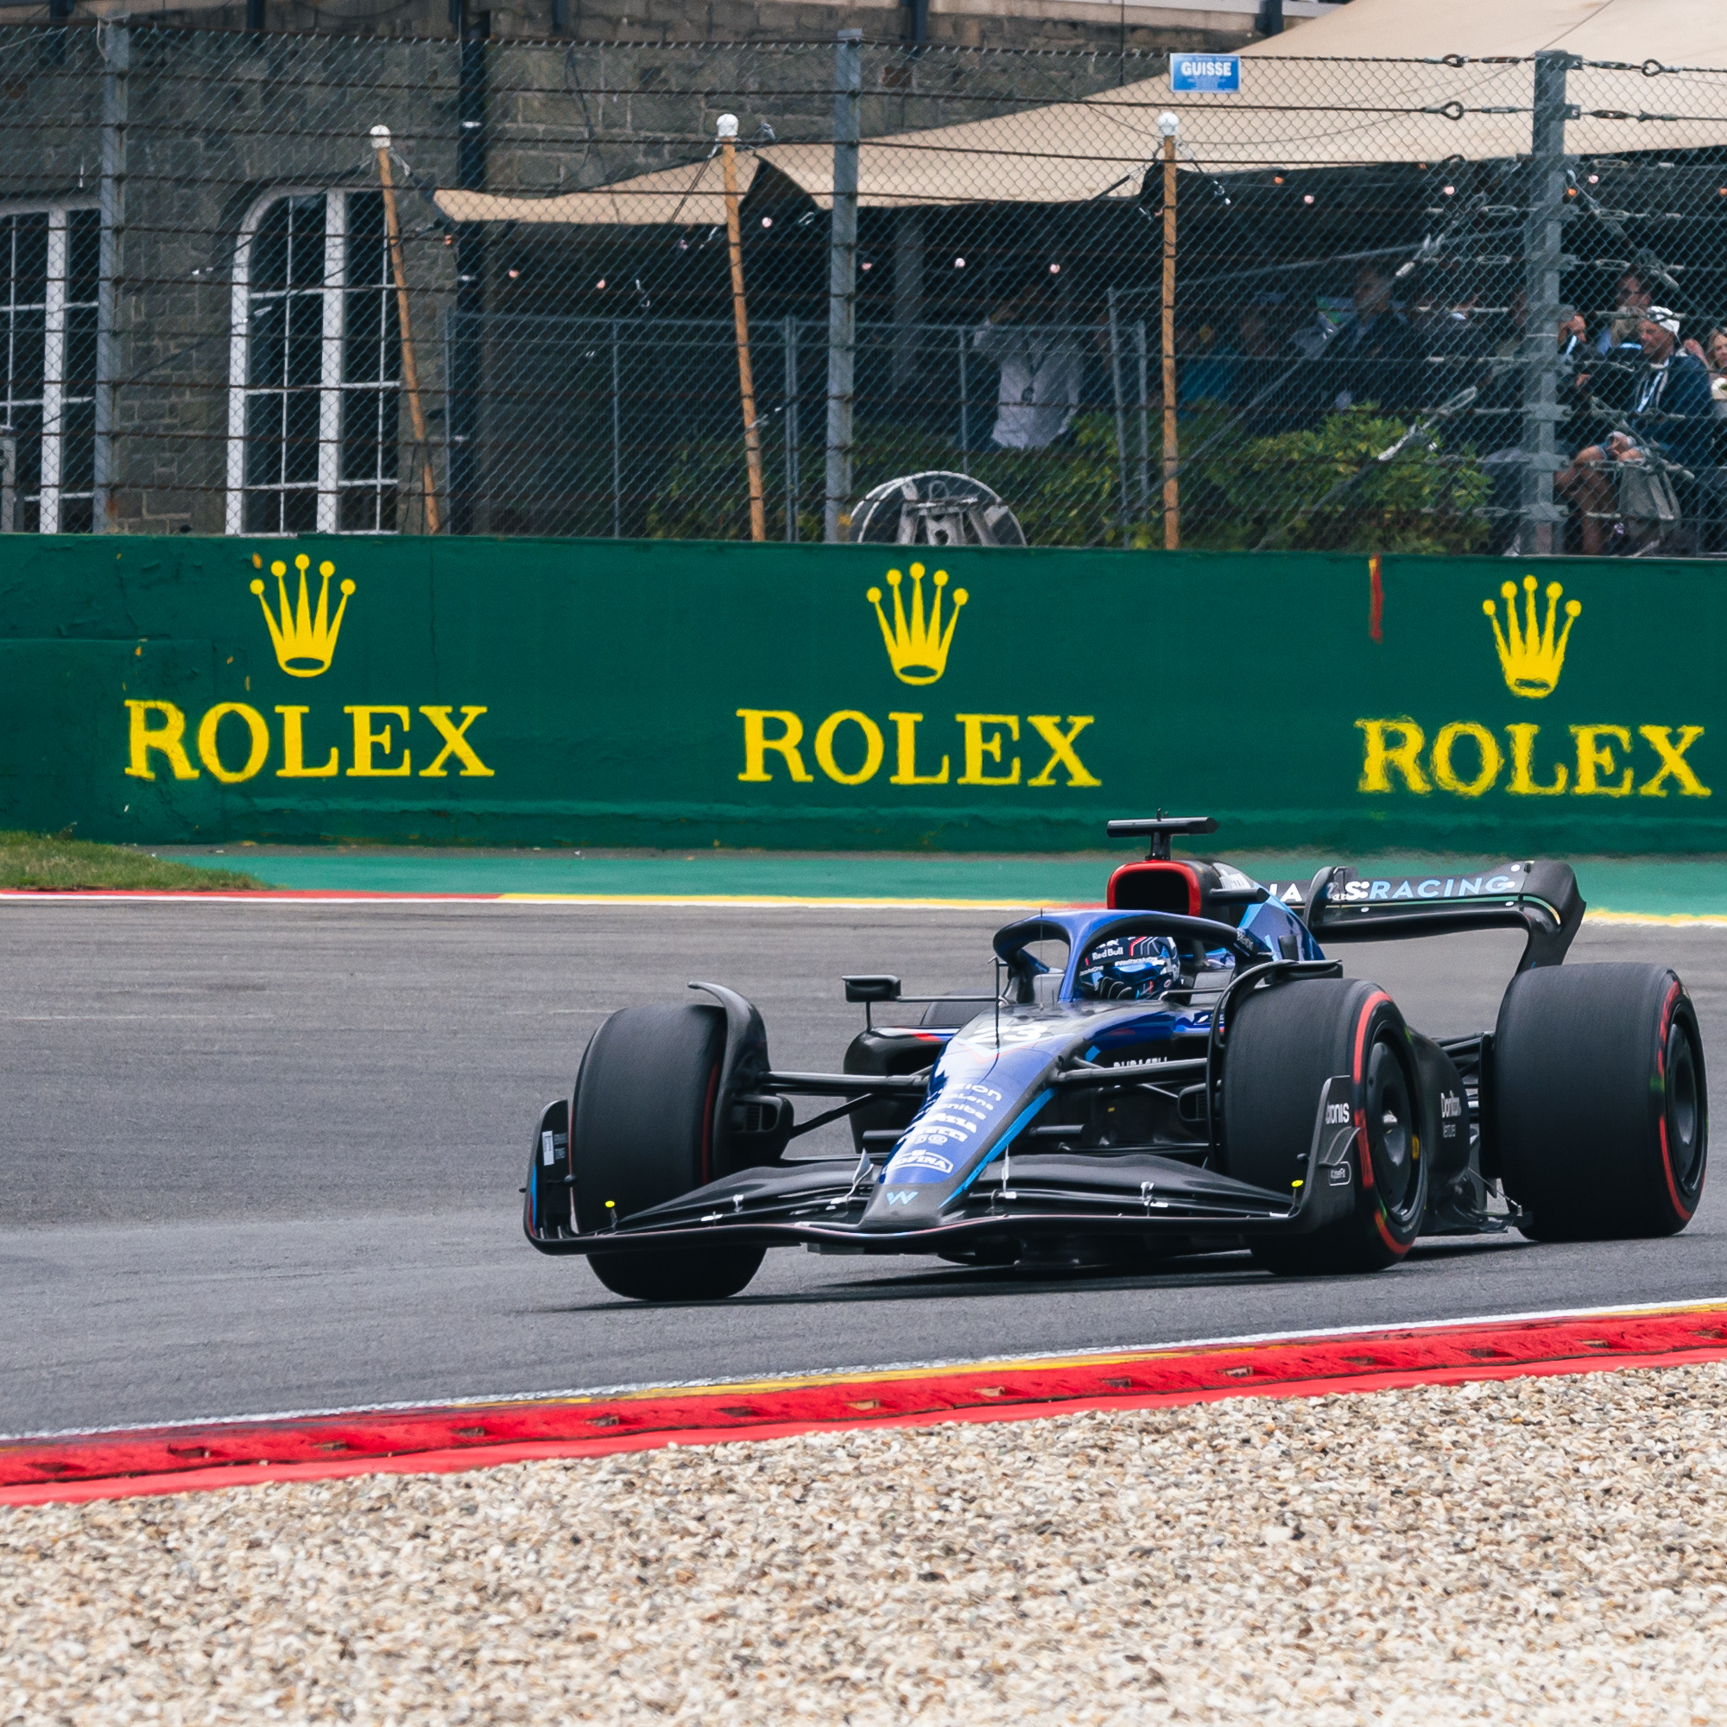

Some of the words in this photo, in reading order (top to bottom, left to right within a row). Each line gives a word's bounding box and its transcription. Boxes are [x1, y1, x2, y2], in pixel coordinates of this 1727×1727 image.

[1181, 61, 1232, 77] GUISSE
[124, 699, 495, 783] ROLEX
[735, 708, 1101, 787] ROLEX
[1355, 719, 1711, 798] ROLEX
[1368, 874, 1511, 901] RACING
[1092, 950, 1107, 961] Red
[1107, 947, 1124, 957] Bull
[970, 1025, 1047, 1043] 23
